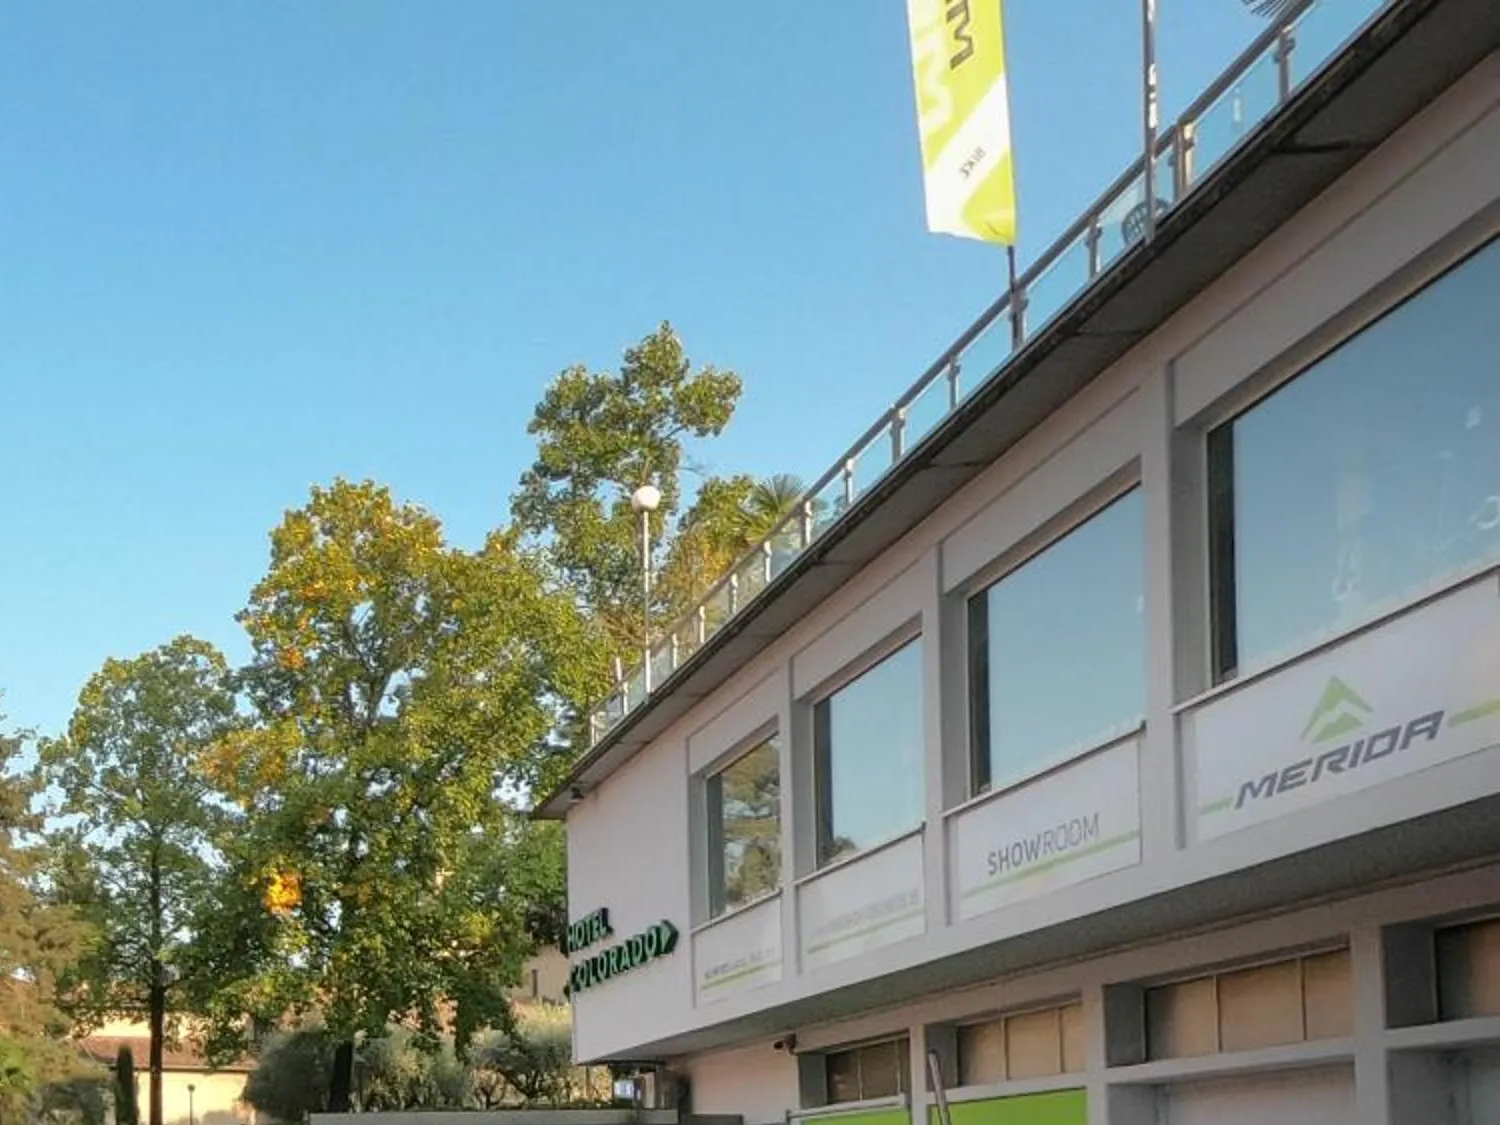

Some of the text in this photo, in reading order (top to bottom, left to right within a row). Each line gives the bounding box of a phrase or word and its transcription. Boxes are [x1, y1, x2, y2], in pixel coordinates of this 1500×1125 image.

[1234, 710, 1446, 811] MERIDA
[986, 812, 1101, 877] SHOWROOM
[567, 907, 613, 952] HOTEL
[569, 924, 663, 992] COLORADO
